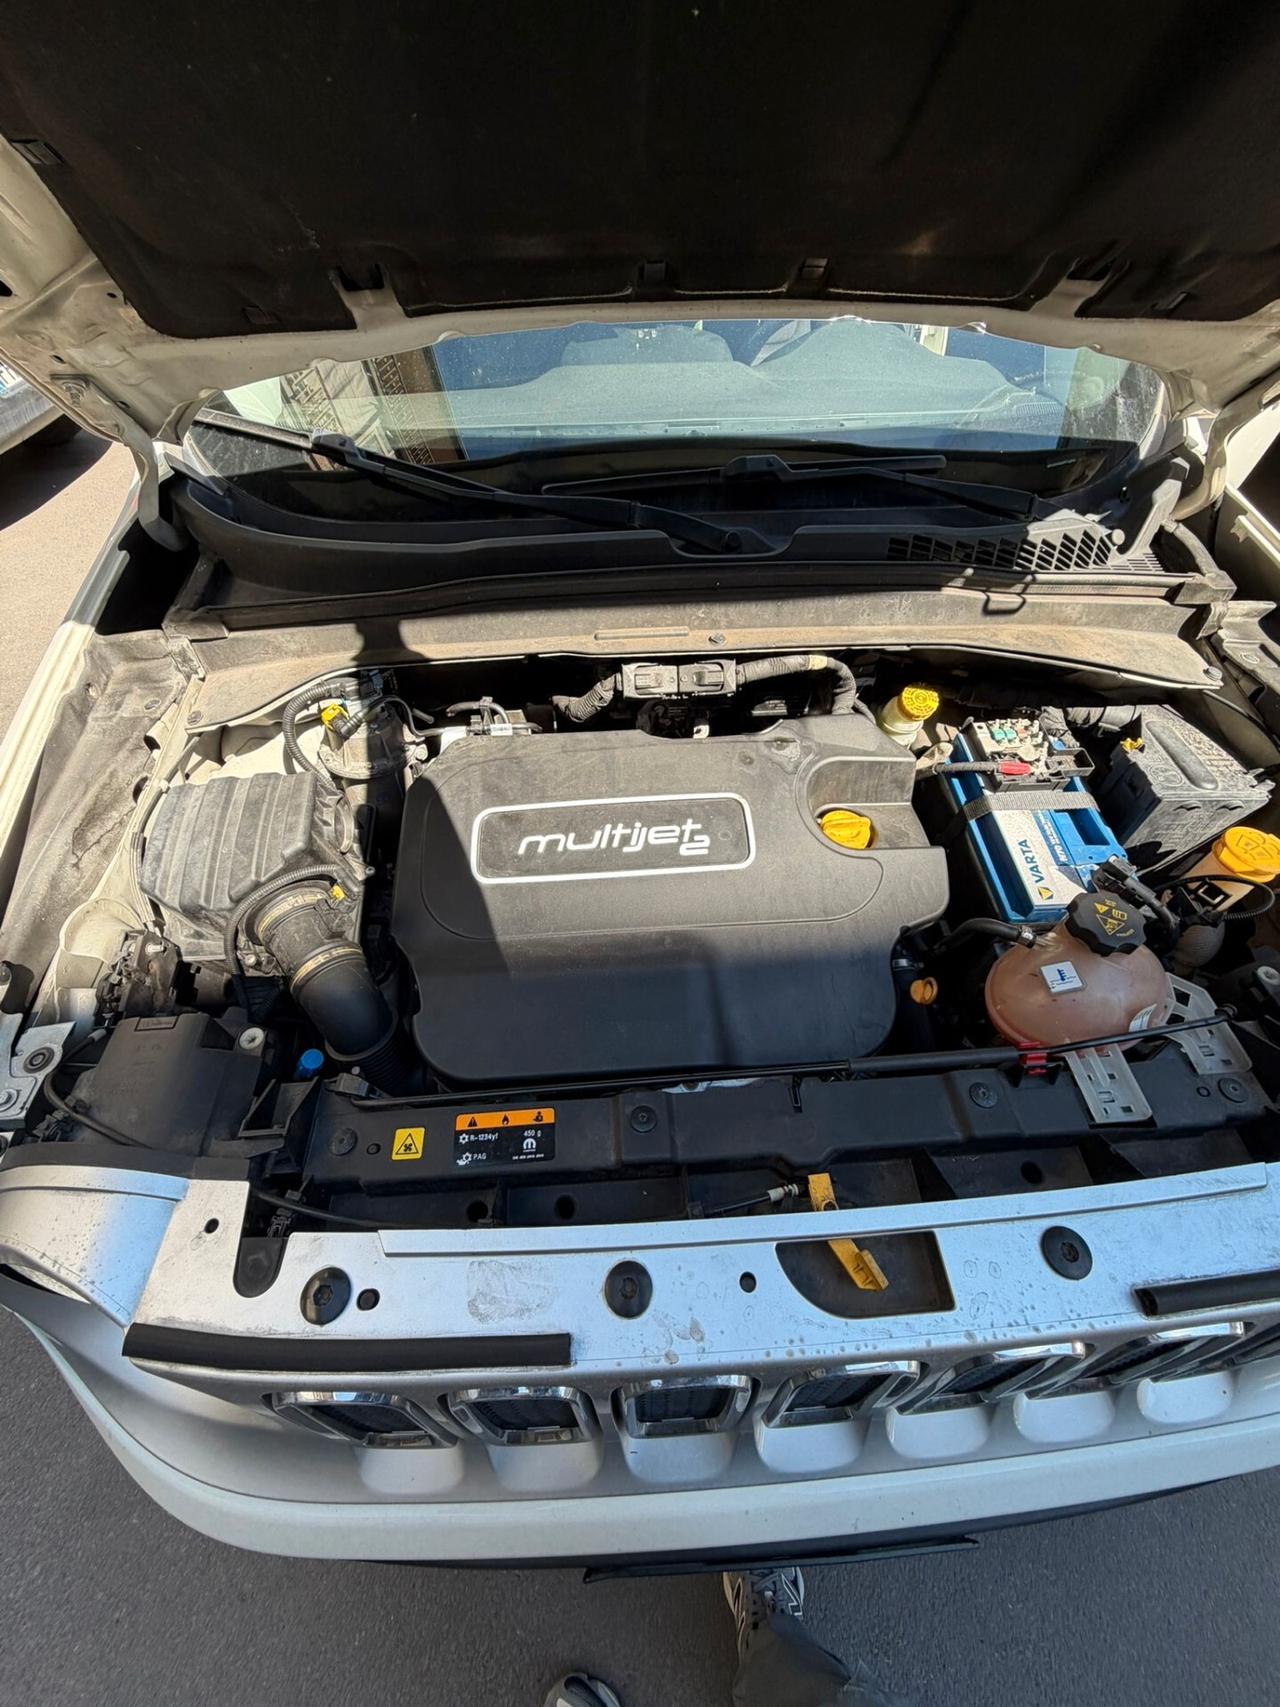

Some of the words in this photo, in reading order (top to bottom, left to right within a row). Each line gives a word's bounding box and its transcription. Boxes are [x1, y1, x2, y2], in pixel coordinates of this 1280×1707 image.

[517, 818, 702, 854] multijet
[1018, 839, 1044, 884] VARTA
[469, 1132, 499, 1142] R-1234yf
[523, 1129, 535, 1137] 450
[473, 1152, 487, 1160] PAG
